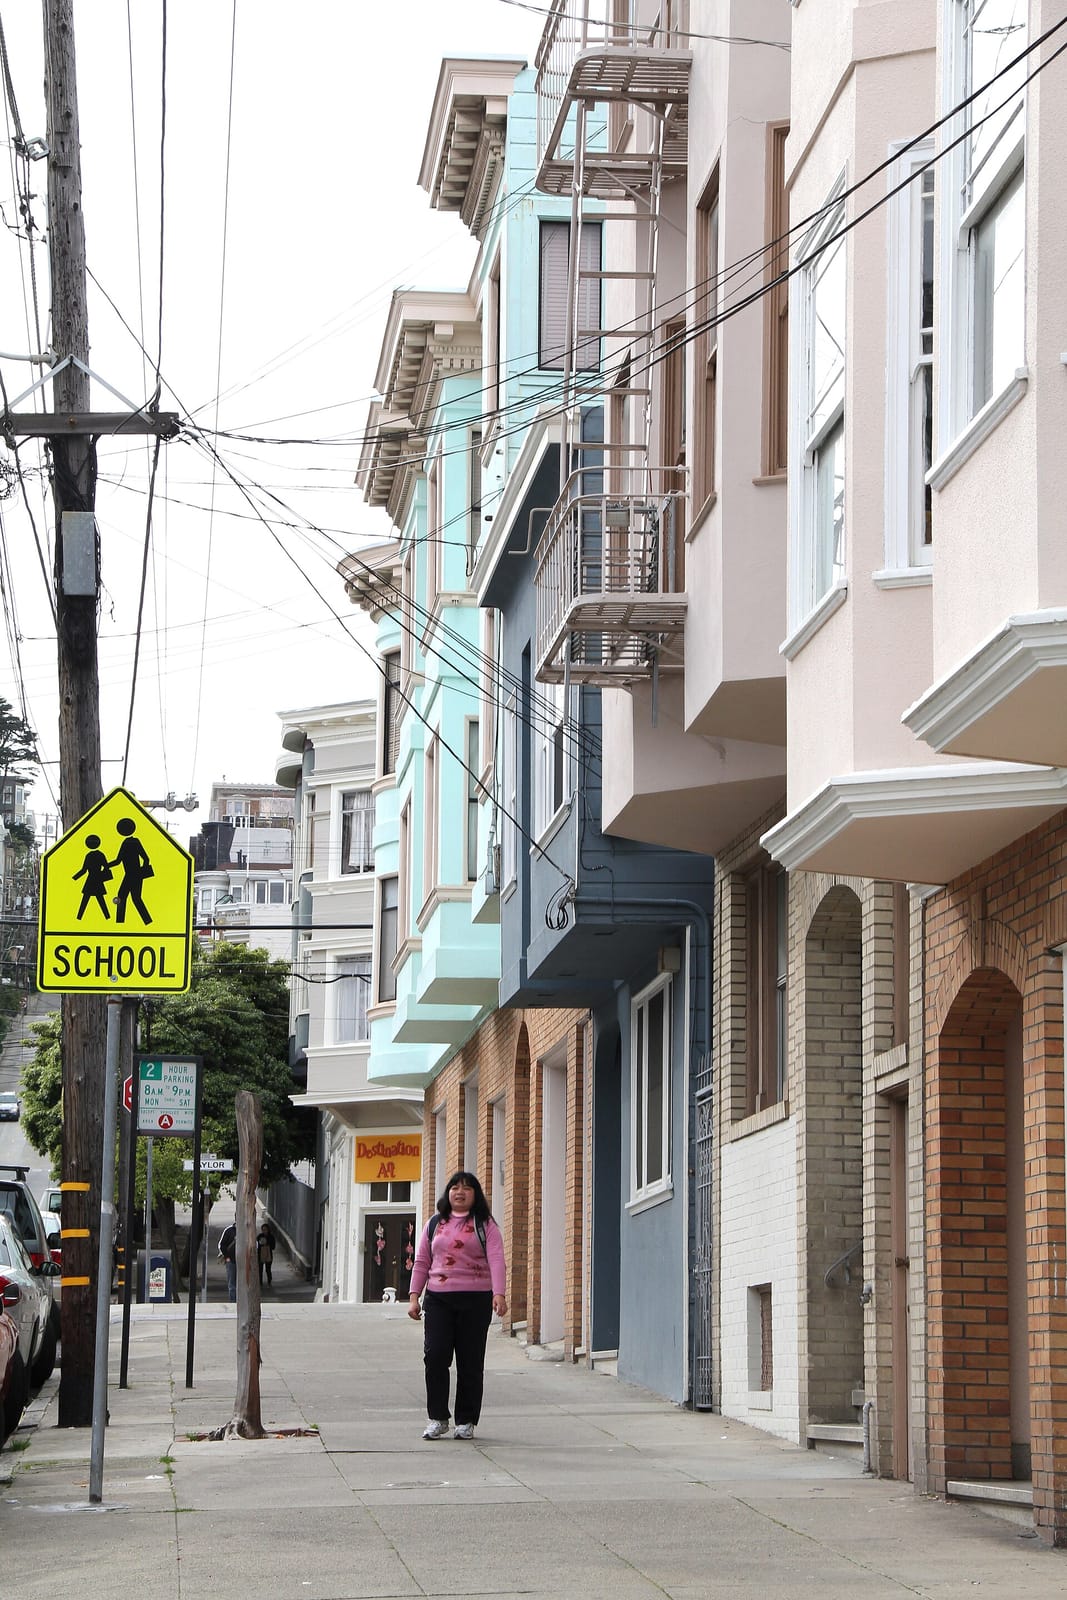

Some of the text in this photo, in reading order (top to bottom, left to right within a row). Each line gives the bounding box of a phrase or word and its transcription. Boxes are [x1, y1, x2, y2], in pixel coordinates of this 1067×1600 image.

[52, 944, 176, 978] SCHOOL
[146, 1062, 188, 1078] 2 HOUR
[163, 1074, 194, 1084] PARKING
[144, 1098, 159, 1106] MON
[179, 1099, 191, 1107] SAT
[160, 1115, 171, 1126] A
[356, 1140, 420, 1159] Destination
[192, 1161, 225, 1169] YLOR
